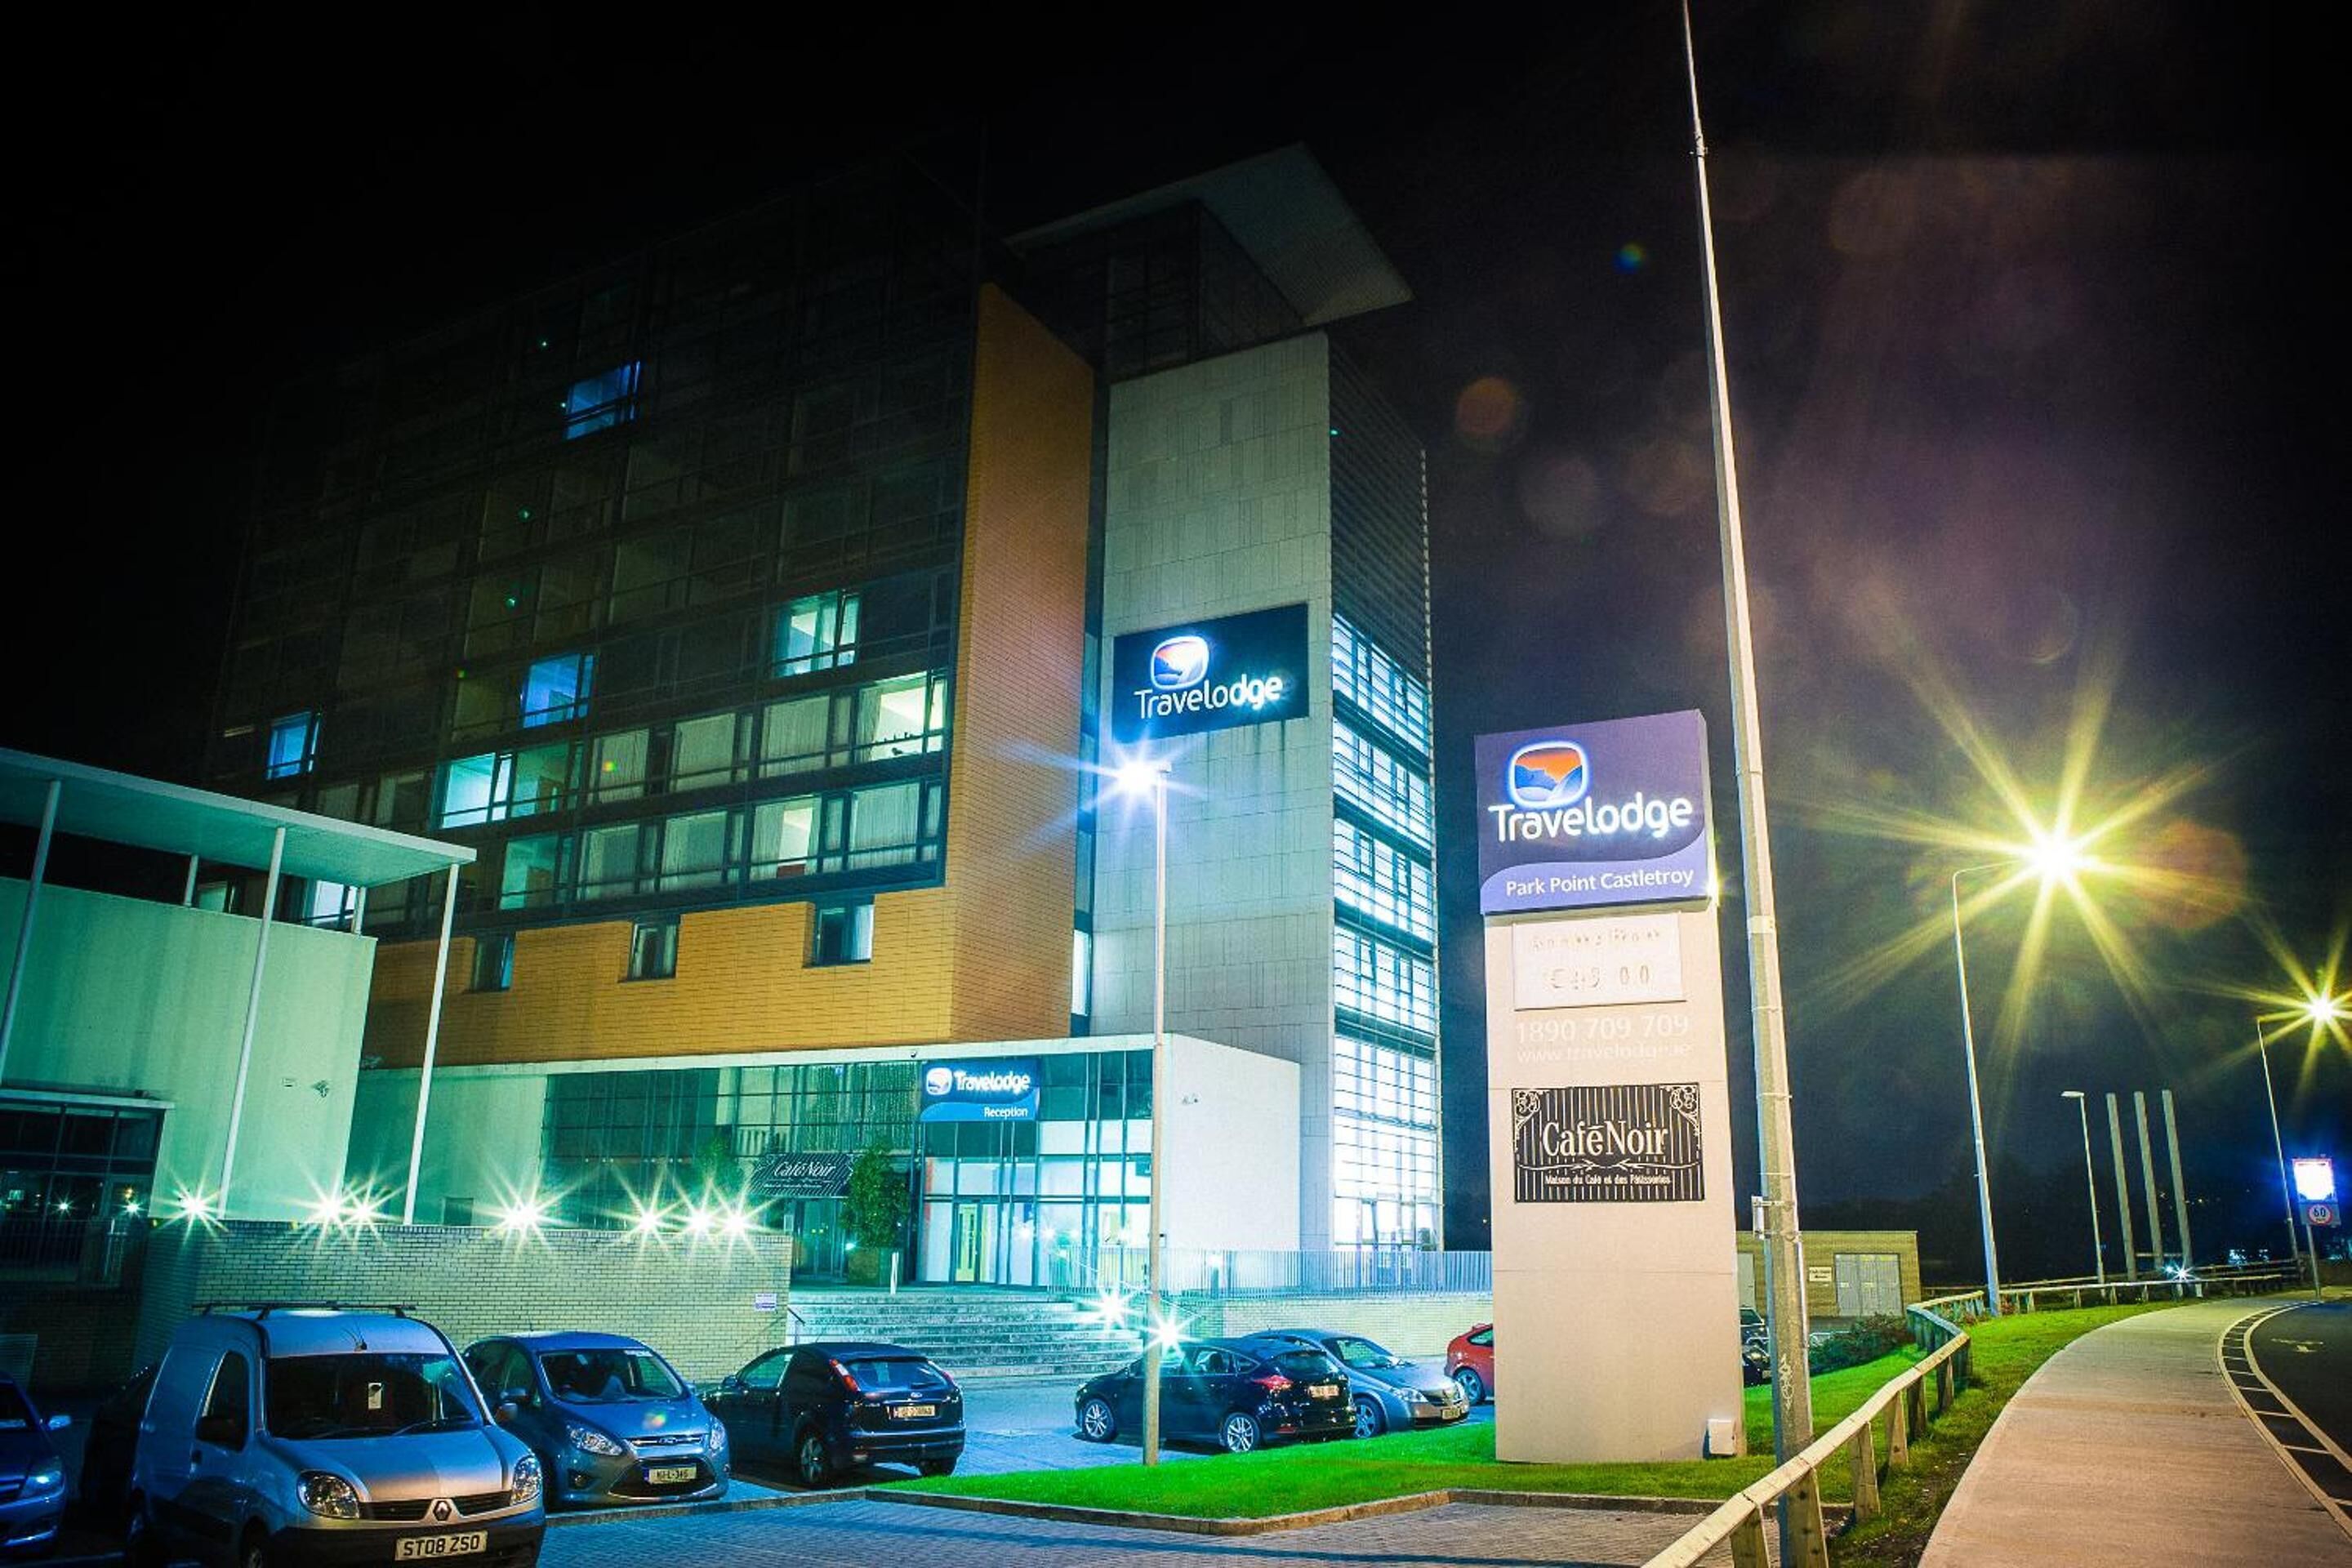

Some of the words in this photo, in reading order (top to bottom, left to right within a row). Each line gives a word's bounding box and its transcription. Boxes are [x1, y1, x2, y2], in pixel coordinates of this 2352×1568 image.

[1134, 674, 1284, 719] Travelodge
[1488, 791, 1693, 842] Travelodge
[1506, 880, 1545, 897] Park
[1551, 875, 1595, 893] Point
[1600, 868, 1695, 889] Castletroy
[1516, 1018, 1576, 1044] 1890
[1583, 1017, 1632, 1040] 709
[1640, 1013, 1690, 1038] 709
[953, 1069, 1031, 1095] Travelodge
[983, 1107, 1028, 1120] Reception
[403, 1539, 445, 1556] ST08
